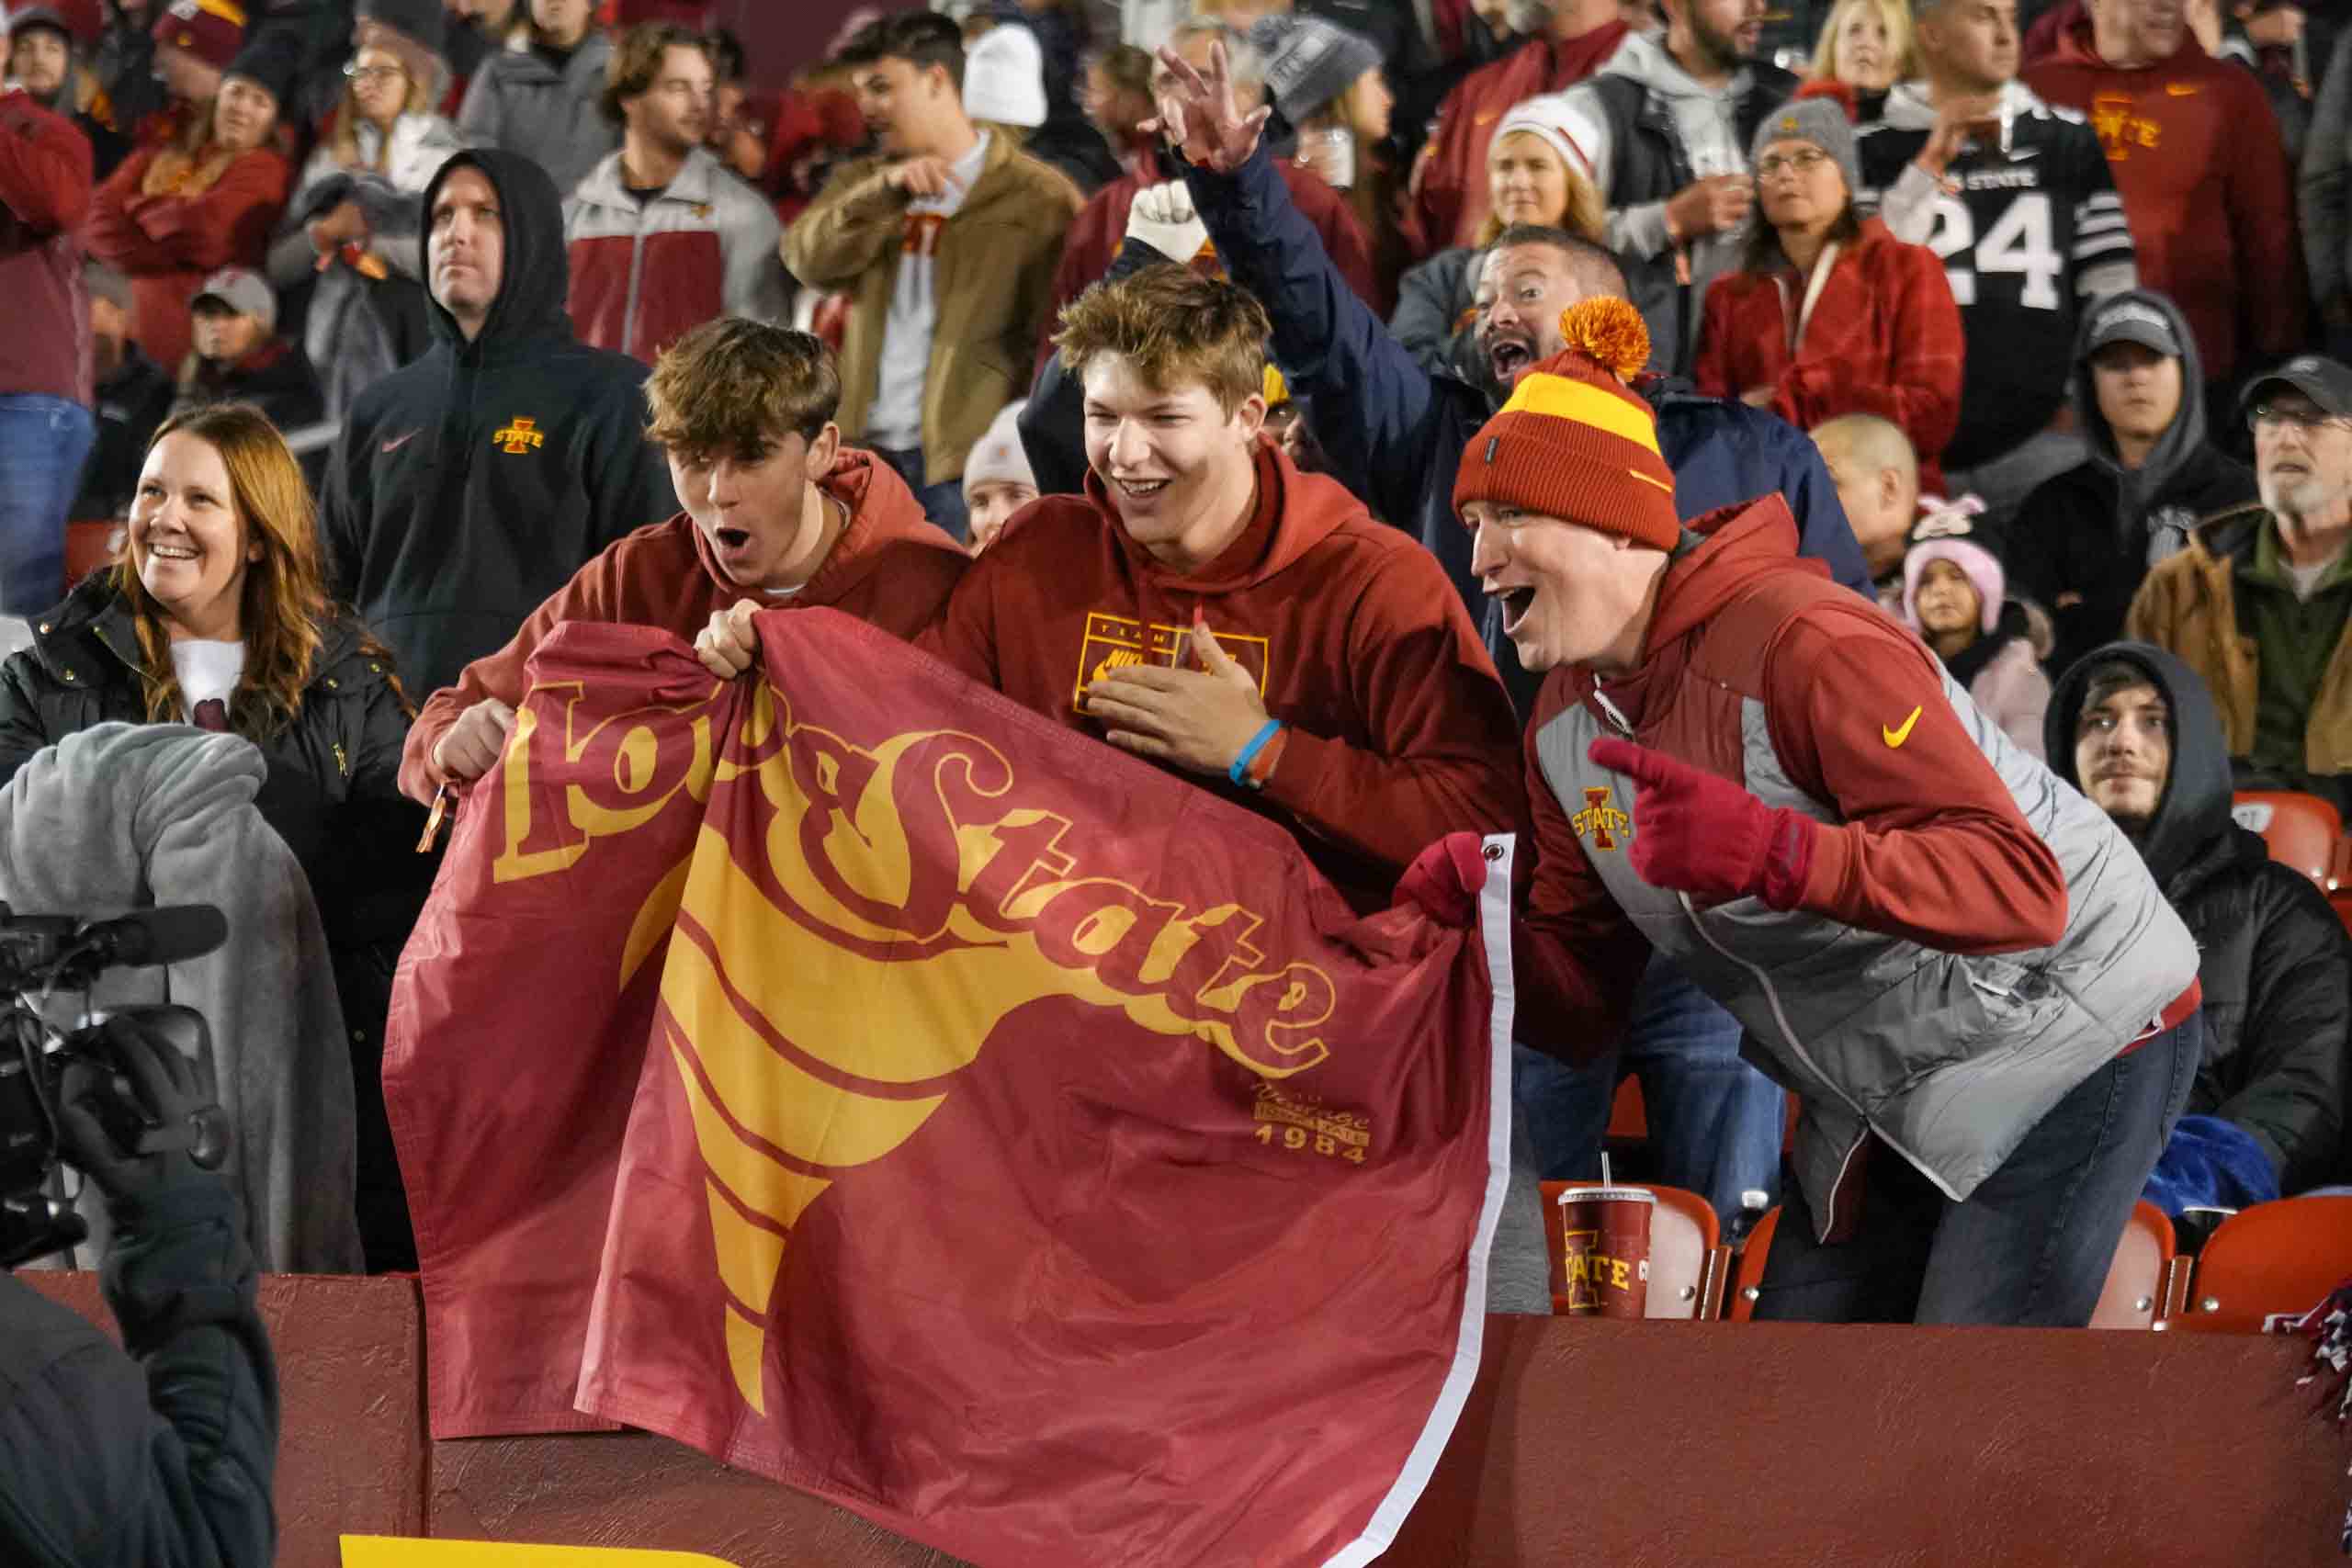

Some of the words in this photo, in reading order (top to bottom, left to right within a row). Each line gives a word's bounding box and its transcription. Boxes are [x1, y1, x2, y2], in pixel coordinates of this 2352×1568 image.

[1928, 194, 2064, 310] 24
[492, 429, 544, 448] STATE
[1102, 624, 1165, 643] TEAM
[1572, 807, 1631, 839] STATE
[772, 728, 1335, 1077] State
[1255, 1123, 1366, 1164] 1984
